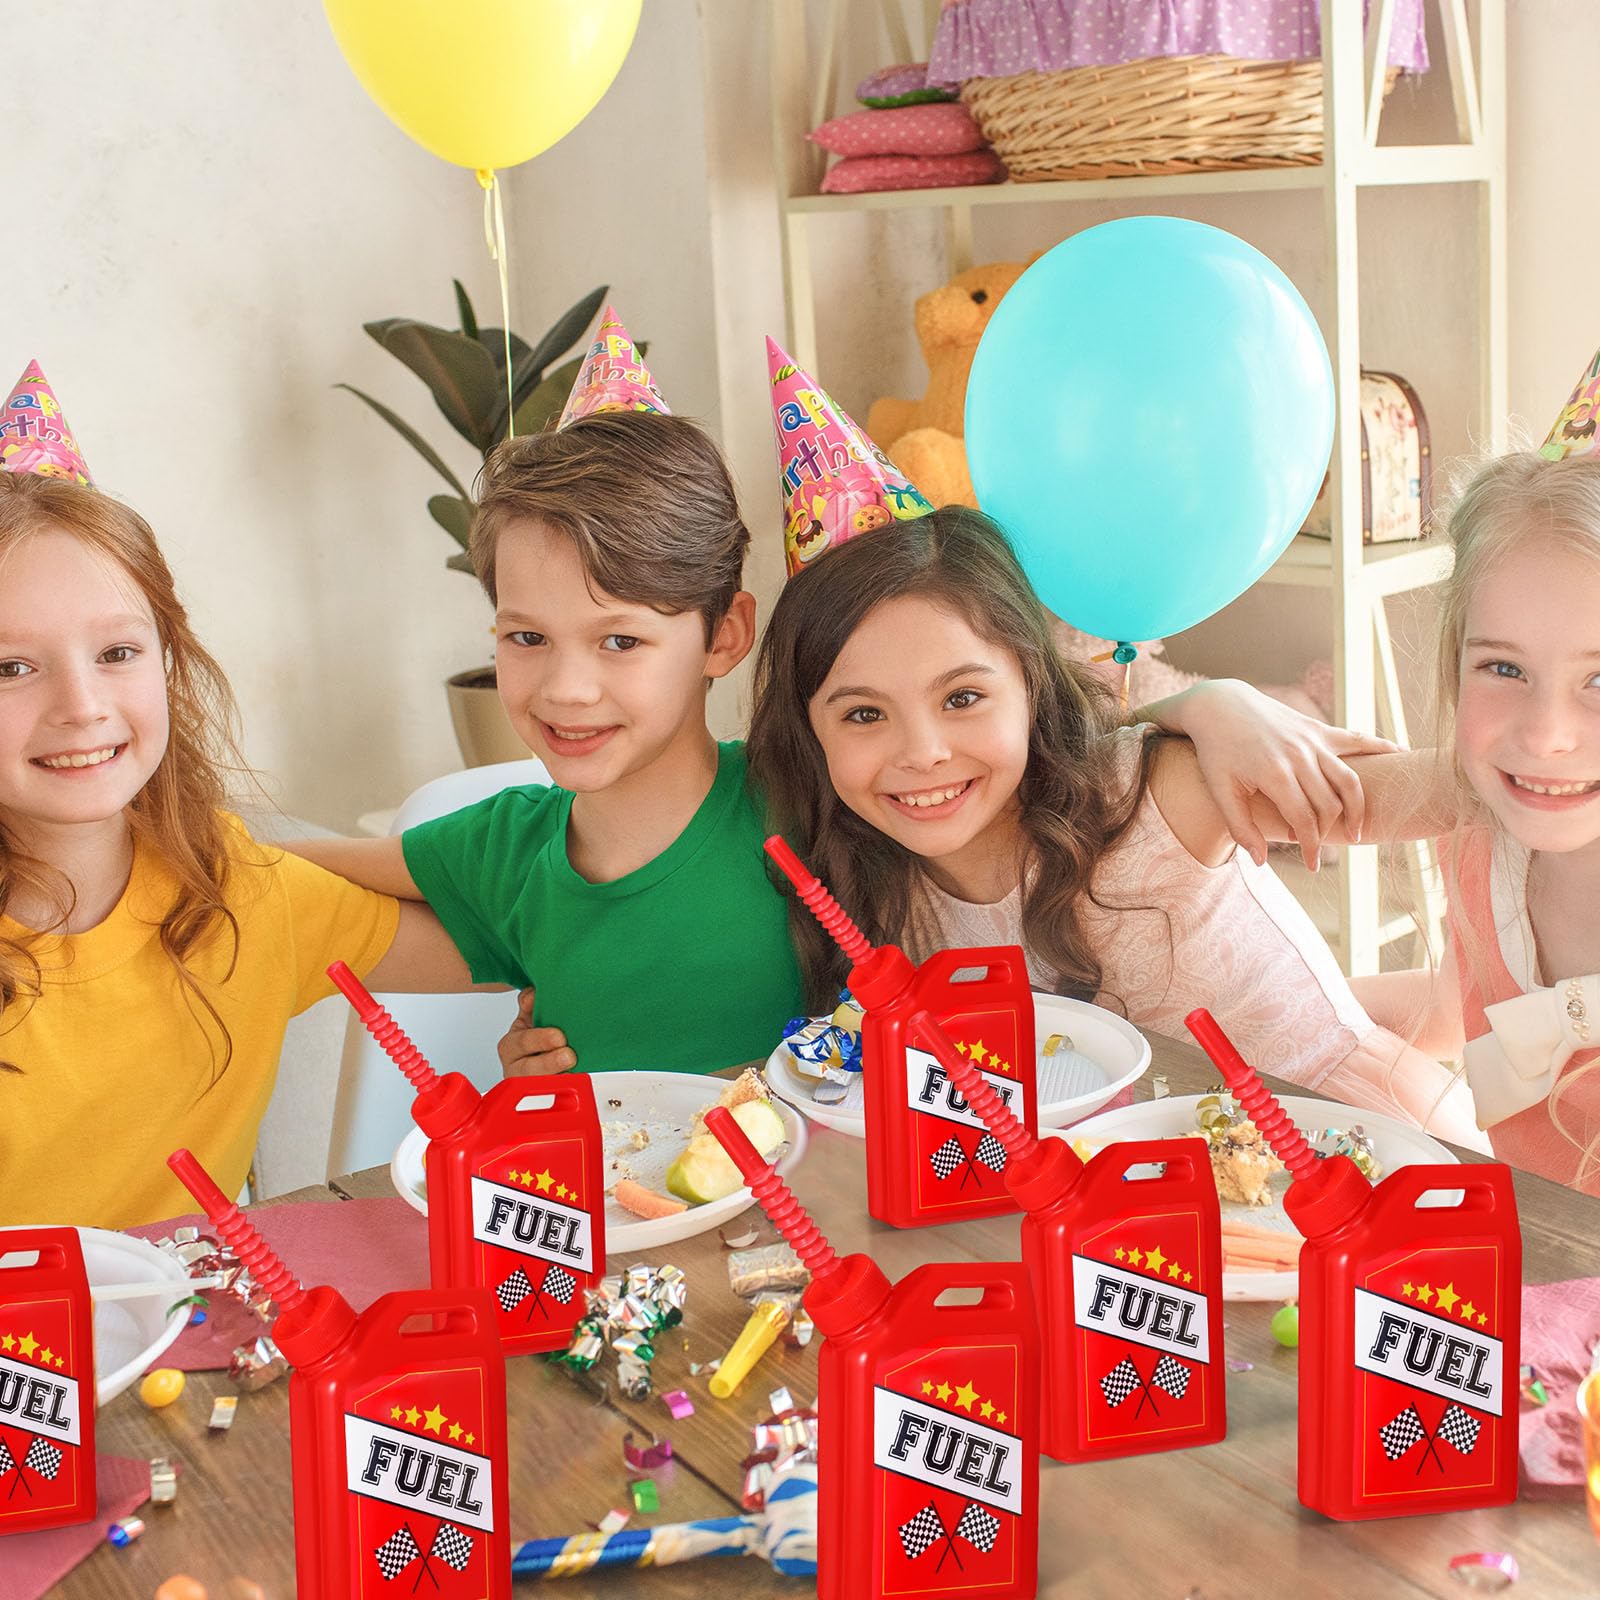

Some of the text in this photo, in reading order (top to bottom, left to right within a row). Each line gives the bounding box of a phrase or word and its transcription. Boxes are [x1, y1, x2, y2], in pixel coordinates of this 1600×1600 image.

[919, 1064, 1013, 1118] FU
[485, 1195, 584, 1259] FUEL
[1088, 1275, 1199, 1348] FUEL
[1370, 1313, 1492, 1397] FUEL
[0, 1368, 71, 1431] UEL
[362, 1437, 482, 1515] FUEL
[889, 1411, 1011, 1496] FUEL
